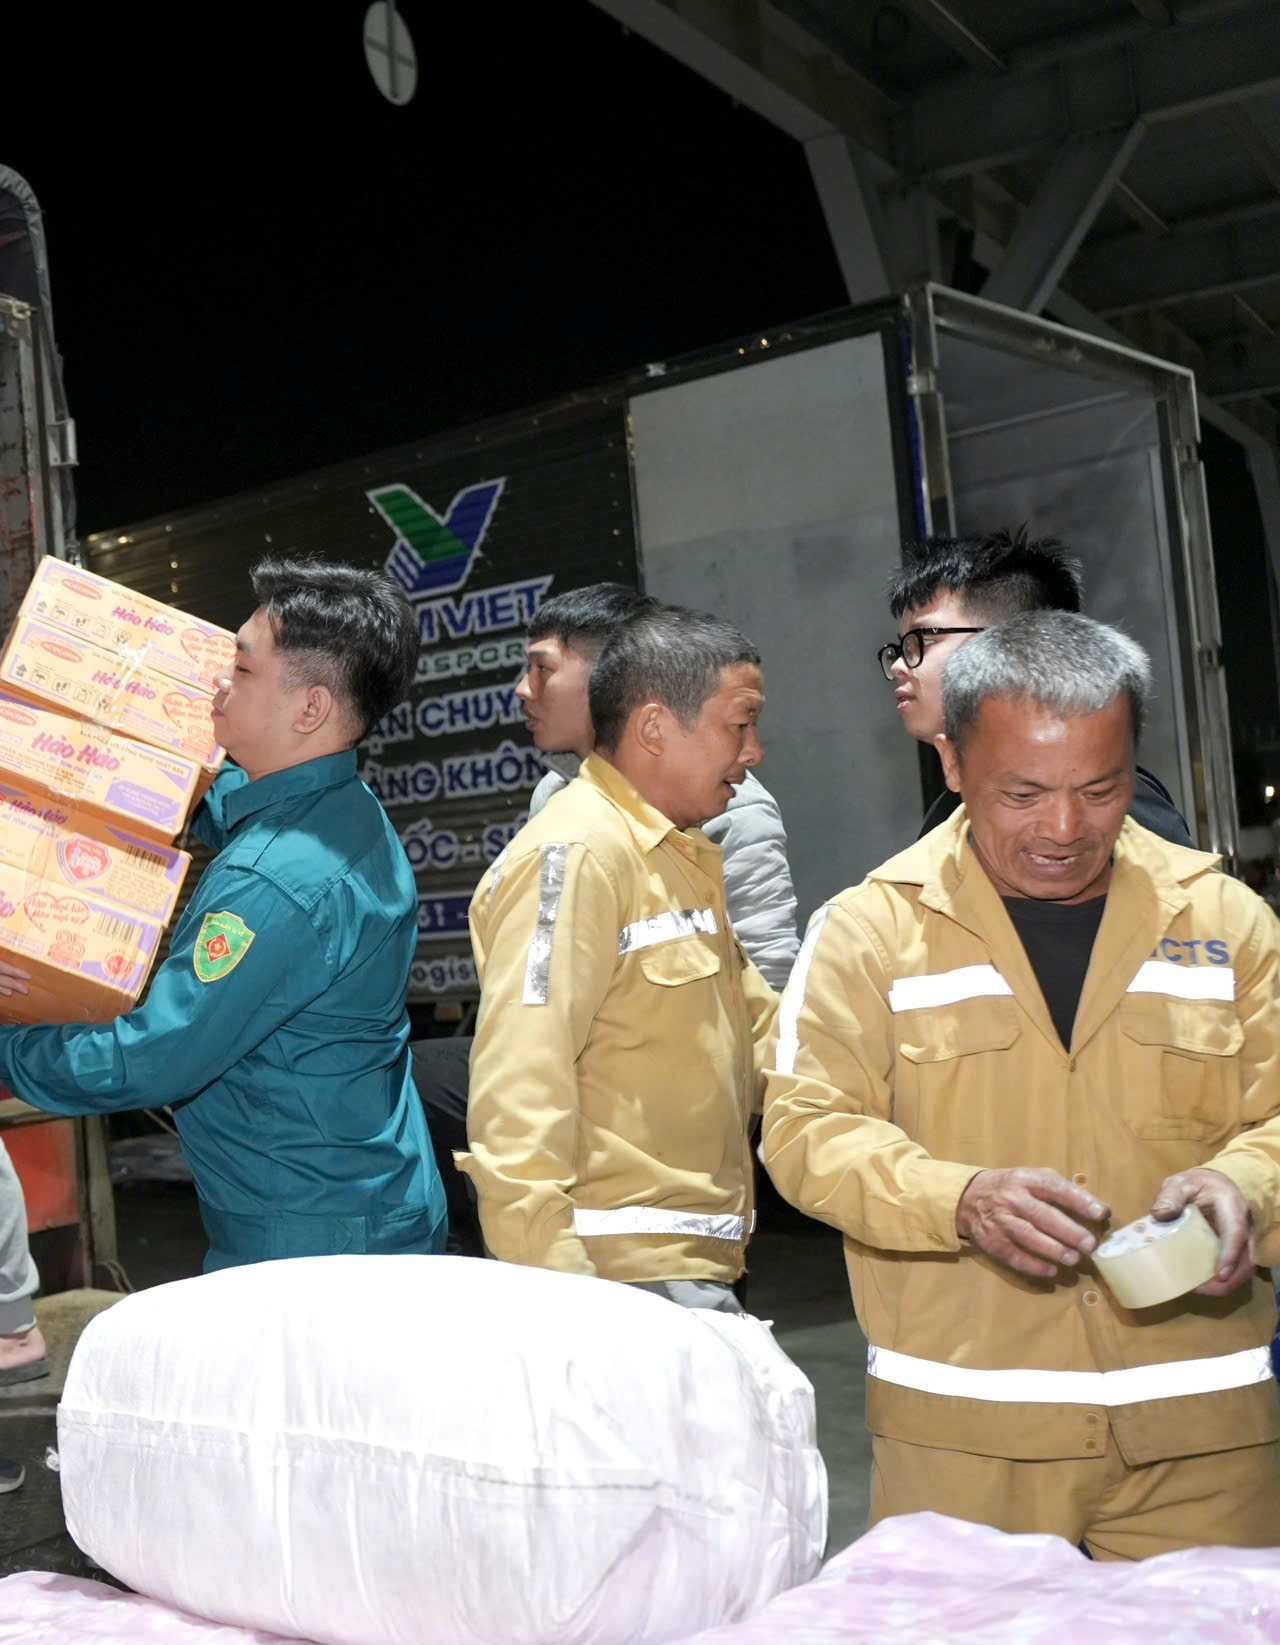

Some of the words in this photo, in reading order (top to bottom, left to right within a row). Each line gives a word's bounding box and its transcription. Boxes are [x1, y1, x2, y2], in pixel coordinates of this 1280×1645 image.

[111, 606, 142, 626] Hảo
[441, 581, 549, 636] VIET
[420, 690, 517, 733] CHUY
[32, 731, 75, 760] Hảo
[76, 743, 121, 772] Hảo
[446, 746, 548, 793] KHÔN
[404, 821, 457, 867] ỐC
[1151, 937, 1230, 965] CTS
[413, 959, 470, 988] ogis
